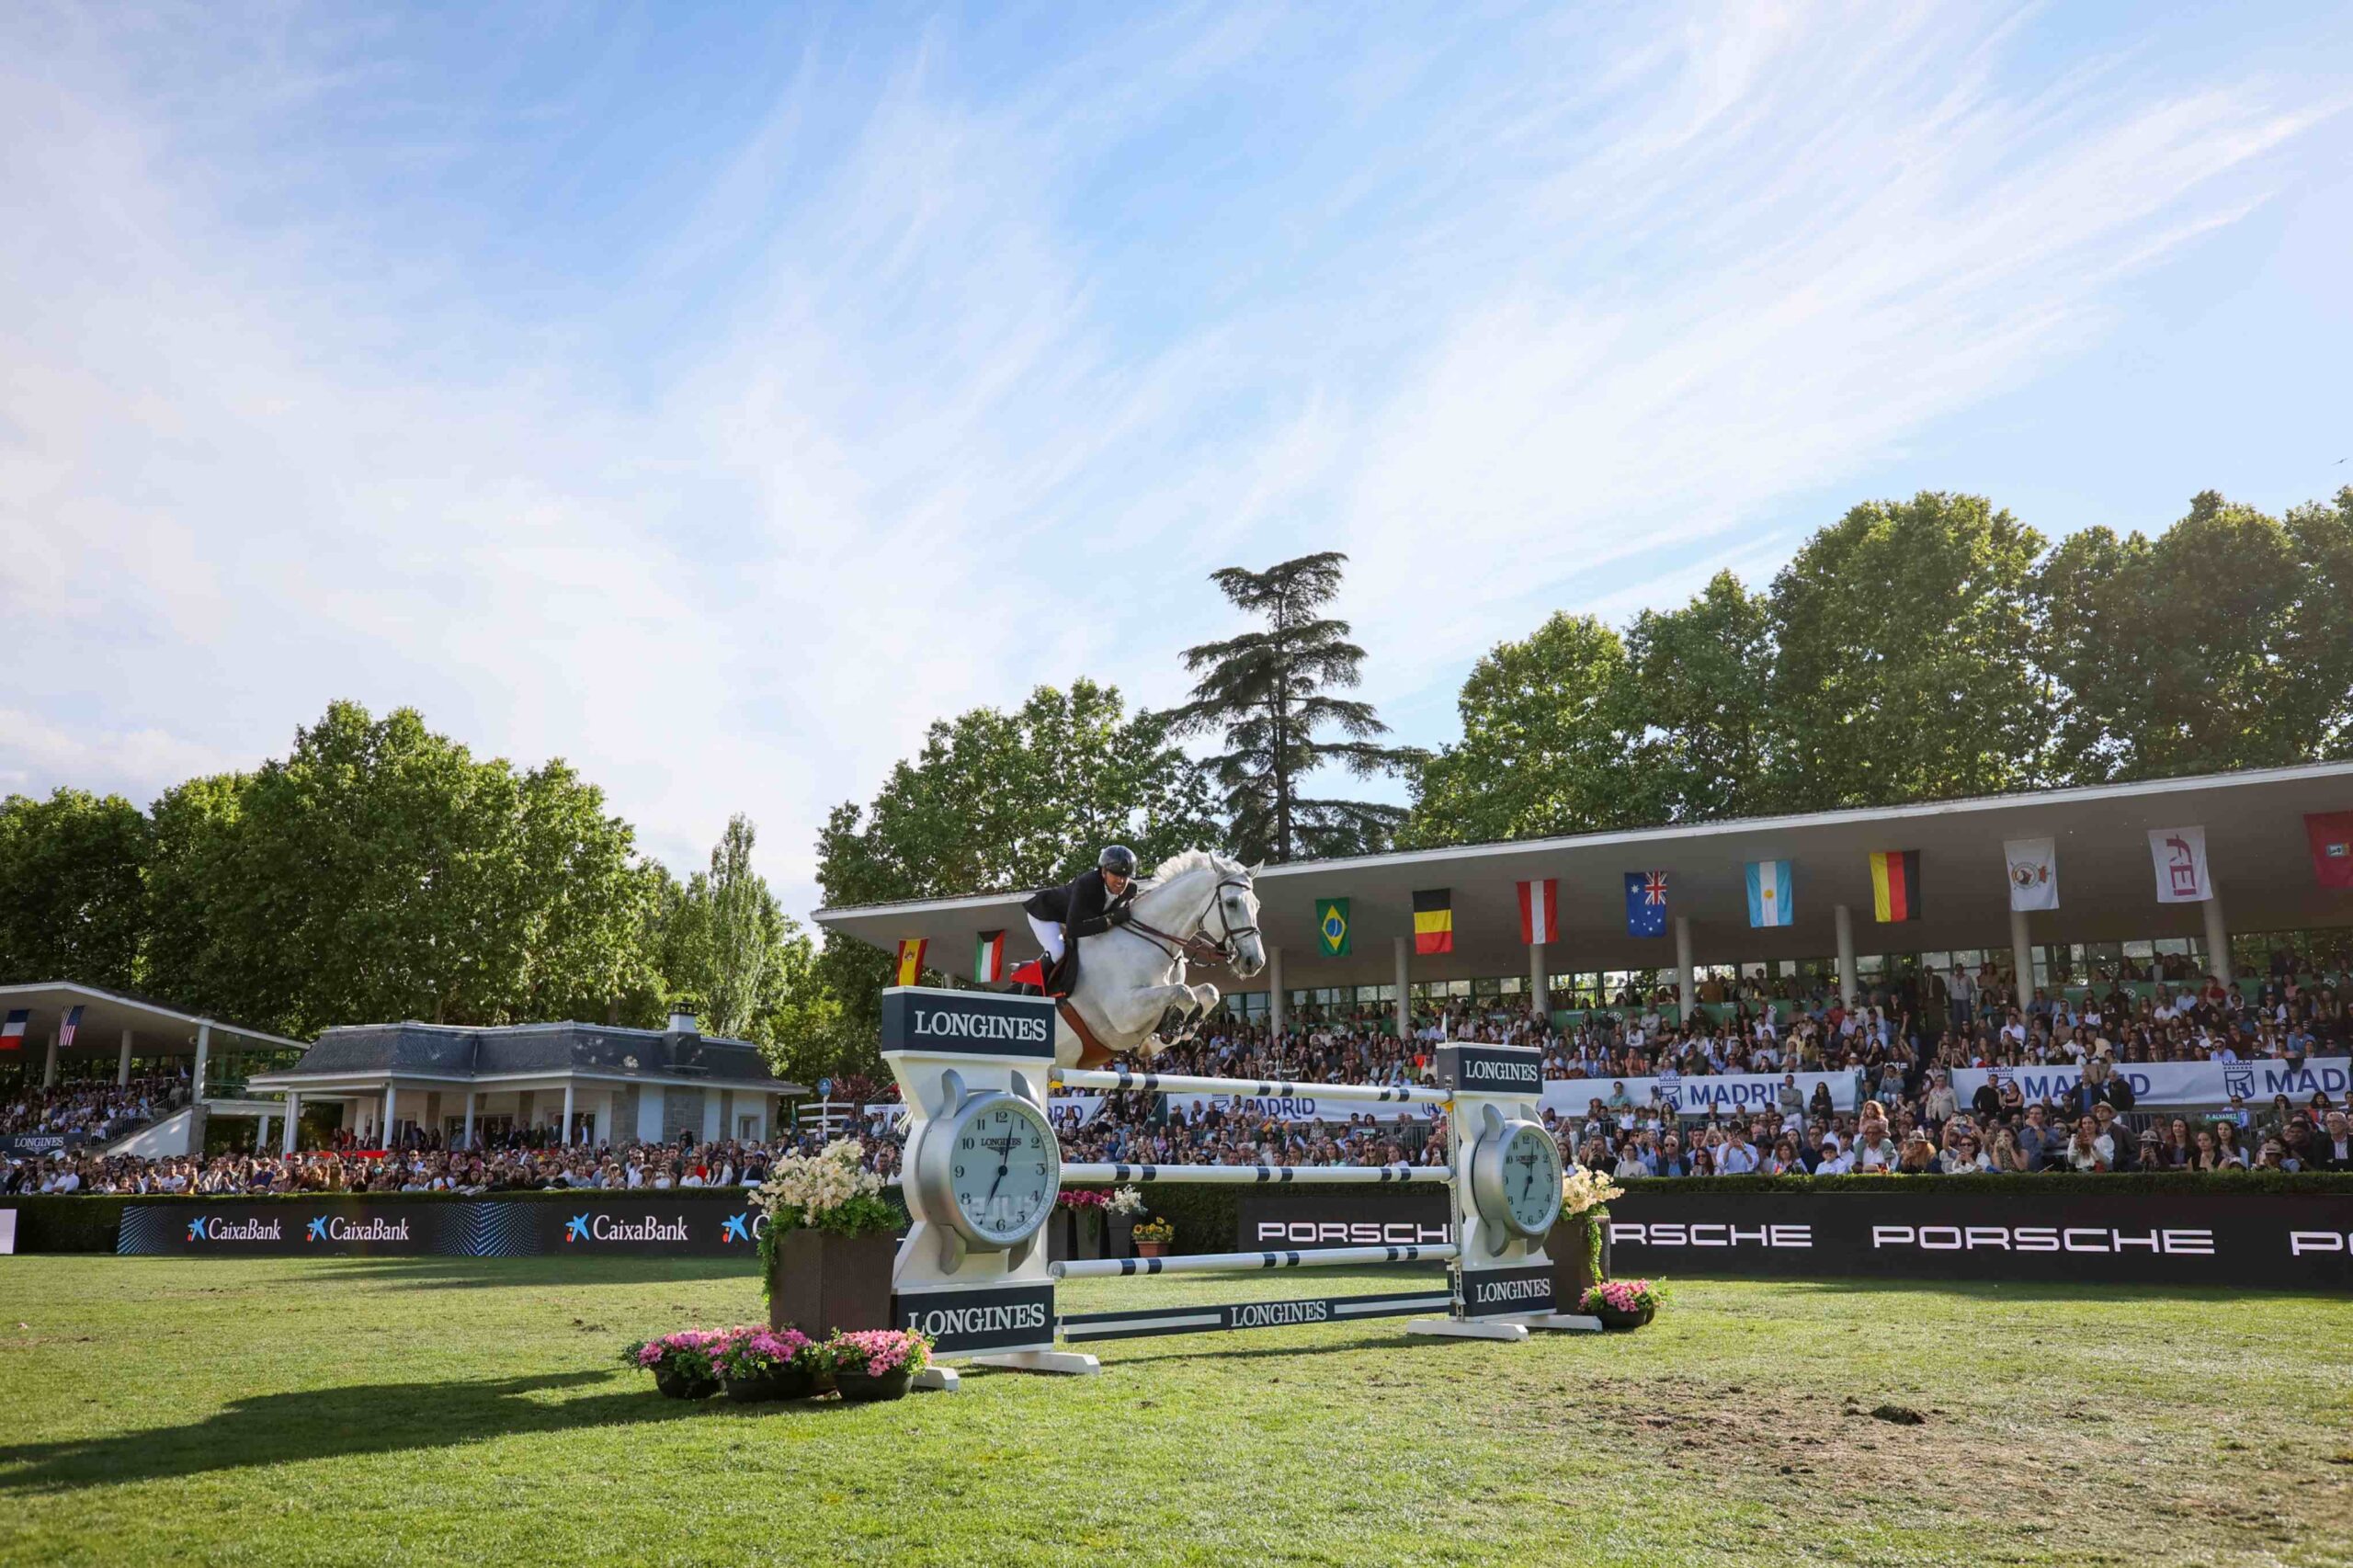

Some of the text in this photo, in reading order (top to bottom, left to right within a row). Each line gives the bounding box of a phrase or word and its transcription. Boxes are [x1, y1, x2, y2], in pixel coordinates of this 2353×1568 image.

[915, 1011, 1047, 1041] LONGINES
[1465, 1060, 1538, 1082] LONGINES
[2265, 1068, 2353, 1093] MAD
[1690, 1083, 1785, 1106] MADRI
[995, 1111, 1008, 1123] 12
[1244, 1097, 1315, 1119] ADRID
[977, 1119, 985, 1131] 11
[1020, 1119, 1025, 1131] 1
[15, 1137, 64, 1147] LONGINES
[962, 1138, 974, 1150] 10
[1030, 1138, 1040, 1149] 2
[955, 1165, 964, 1177] 9
[1036, 1163, 1045, 1176] 3
[961, 1193, 971, 1205] 8
[1029, 1190, 1040, 1202] 4
[593, 1214, 688, 1241] CaixaBank
[976, 1212, 985, 1225] 7
[996, 1220, 1006, 1232] 6
[1017, 1210, 1025, 1223] 5
[209, 1217, 281, 1240] CaixaBank
[330, 1216, 409, 1241] CaixaBank
[1257, 1222, 1454, 1244] PORSCH
[1610, 1223, 1812, 1246] RSCHE
[1872, 1225, 2215, 1255] PORSCHE
[2290, 1231, 2353, 1256] P
[1476, 1278, 1551, 1302] LONGINES
[908, 1303, 1045, 1336] LONGINES
[1231, 1301, 1326, 1327] LONGINES
